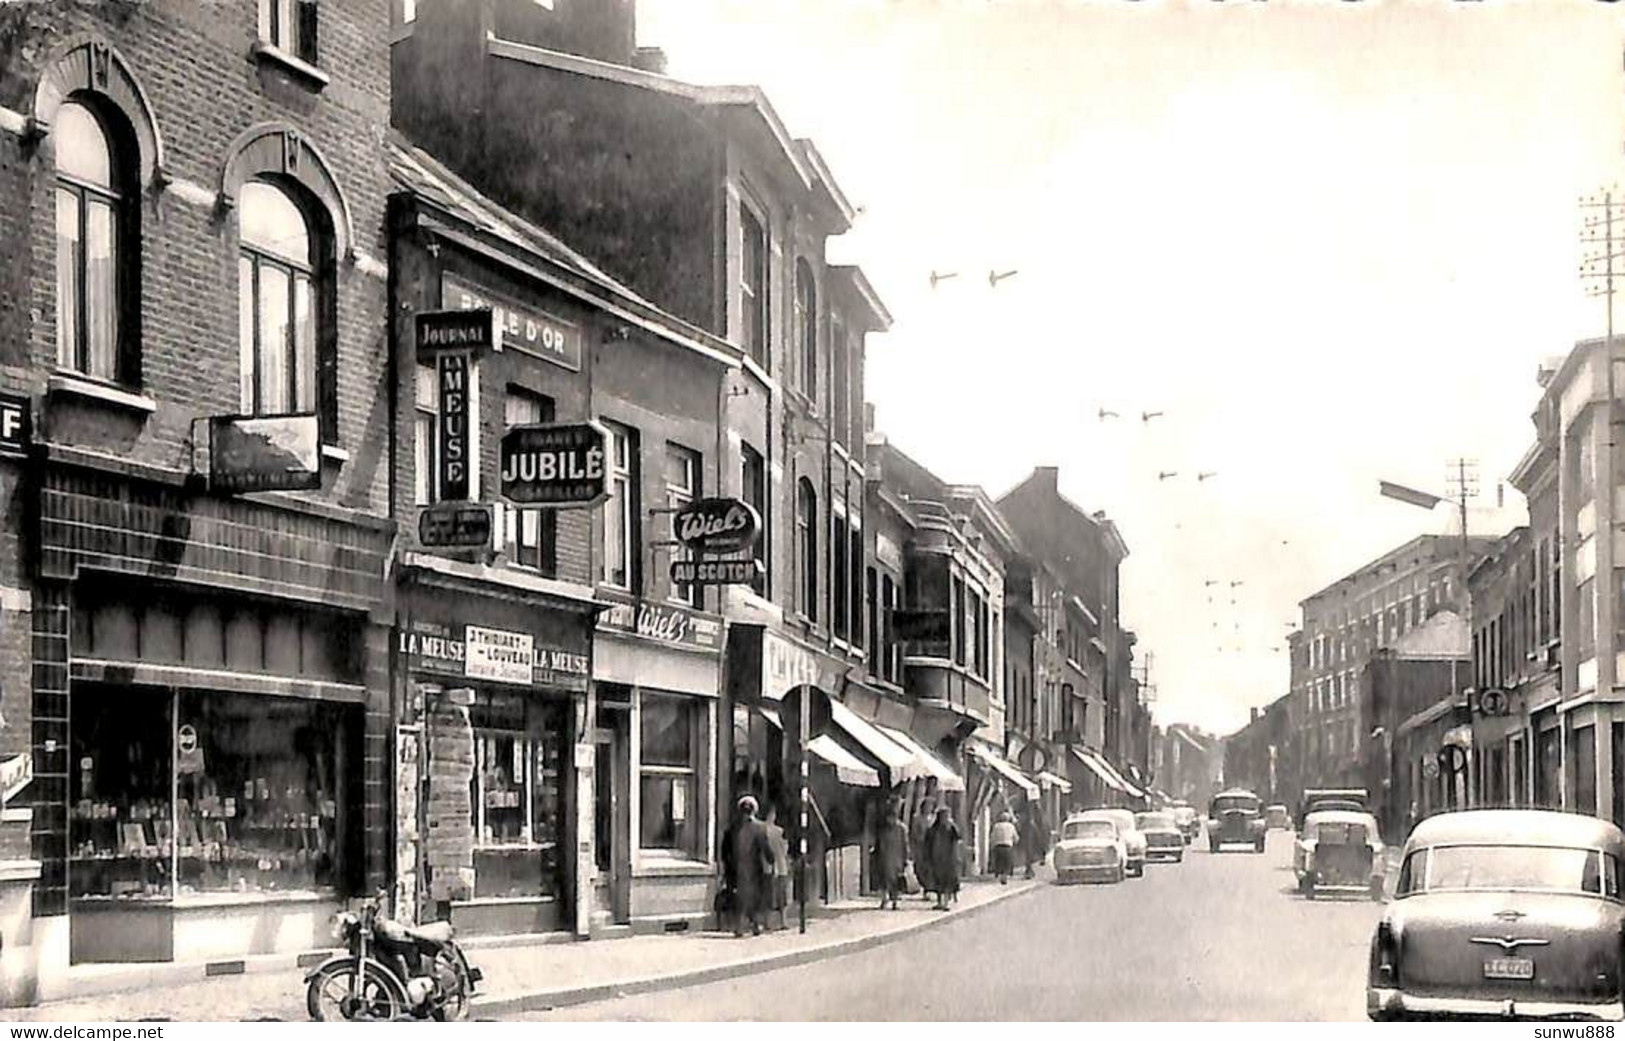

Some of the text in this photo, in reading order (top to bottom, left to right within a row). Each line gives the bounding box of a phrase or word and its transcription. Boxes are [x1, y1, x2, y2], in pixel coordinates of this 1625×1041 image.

[526, 320, 564, 353] D'OR
[444, 370, 463, 483] MEUSE
[501, 446, 603, 482] JUBILÉ
[680, 505, 747, 540] Wiel's
[674, 563, 755, 581] AU SCOTCH
[637, 603, 688, 643] Wiel's
[400, 632, 465, 661] LA MEUSE
[533, 650, 549, 669] LA
[551, 651, 588, 674] MEUSE
